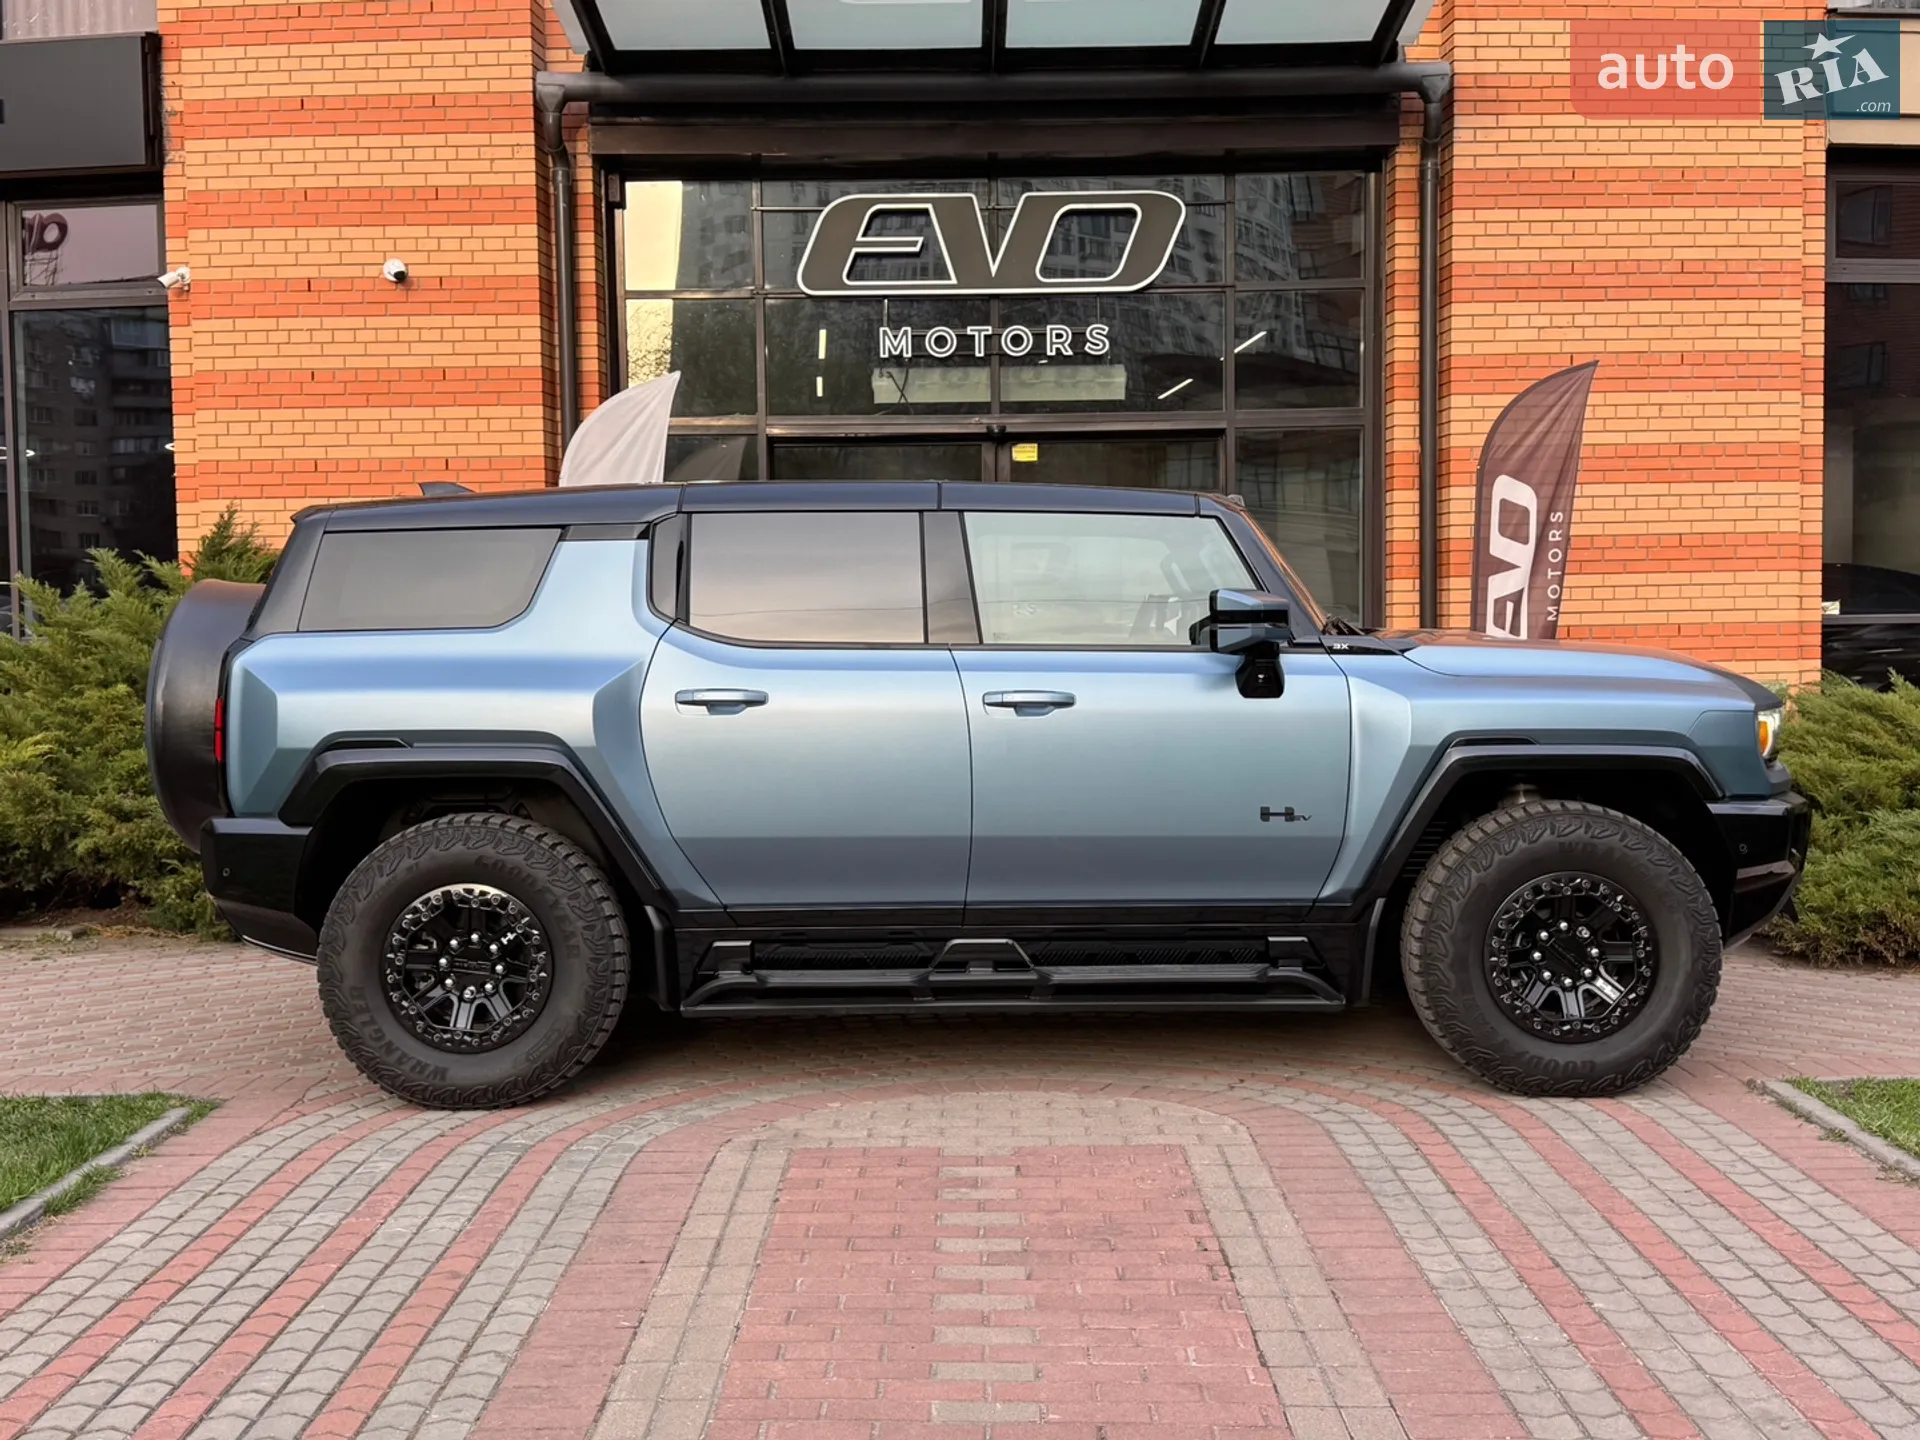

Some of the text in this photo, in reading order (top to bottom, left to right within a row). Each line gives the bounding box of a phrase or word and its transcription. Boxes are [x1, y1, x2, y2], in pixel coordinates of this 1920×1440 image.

[797, 190, 1186, 296] EVO
[878, 323, 1111, 358] MOTORS
[1546, 511, 1564, 621] MOTORS
[350, 985, 449, 1082] WRANGLER
